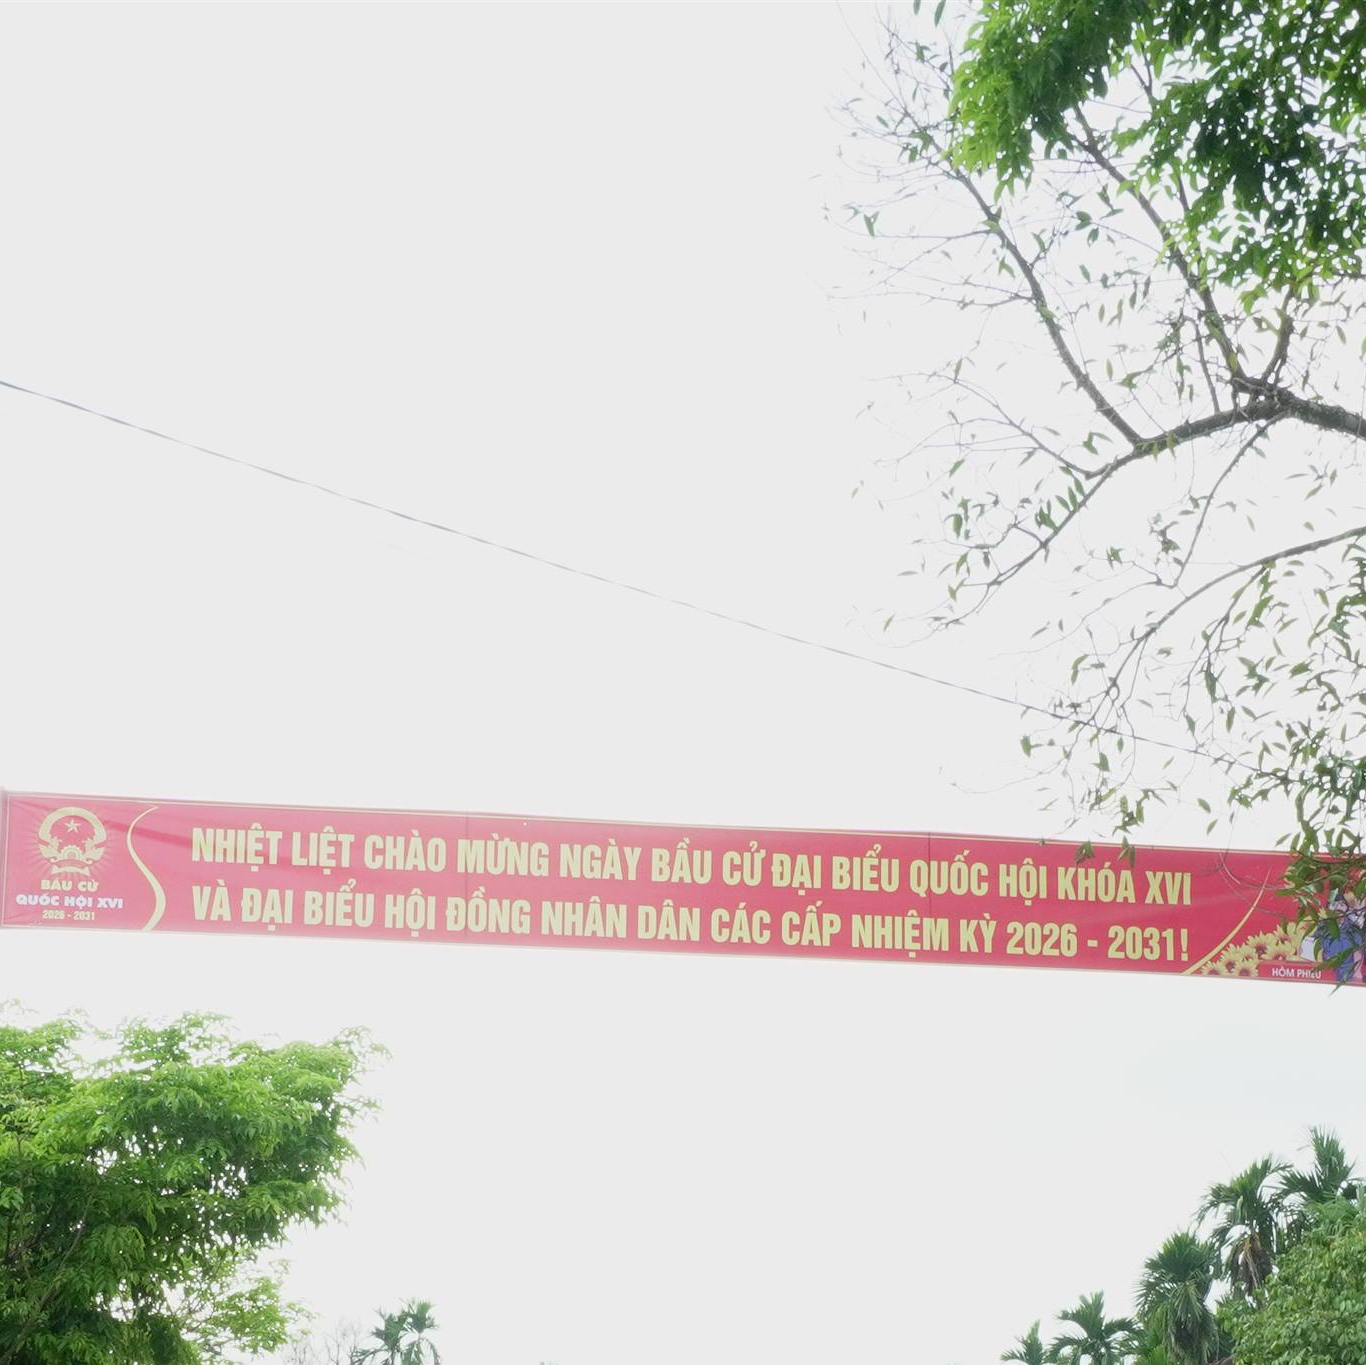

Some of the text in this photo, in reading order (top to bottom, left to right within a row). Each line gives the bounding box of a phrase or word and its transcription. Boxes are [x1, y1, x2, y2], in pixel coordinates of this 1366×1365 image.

[16, 892, 124, 910] QUỐC HỘI XVI
[191, 822, 1192, 906] NHIỆT LIỆT CHÀO MỪNG NGÀY BẦU CỬ ĐẠI BIỂU QUỐC HỘI KHÓA XVI
[192, 879, 232, 922] VÀ
[241, 887, 293, 931] ĐẠI
[303, 879, 374, 927] BIỂU
[385, 888, 436, 937] HỘI
[446, 886, 531, 934] ĐỒNG
[541, 896, 627, 938] NHÂN
[637, 899, 700, 942] DÂN
[711, 902, 771, 944] CÁC
[781, 901, 841, 946] CẤP
[851, 909, 949, 959] NHIỆM
[959, 913, 997, 953] KỲ
[1006, 921, 1078, 957] 2026
[1107, 925, 1189, 962] 2031!
